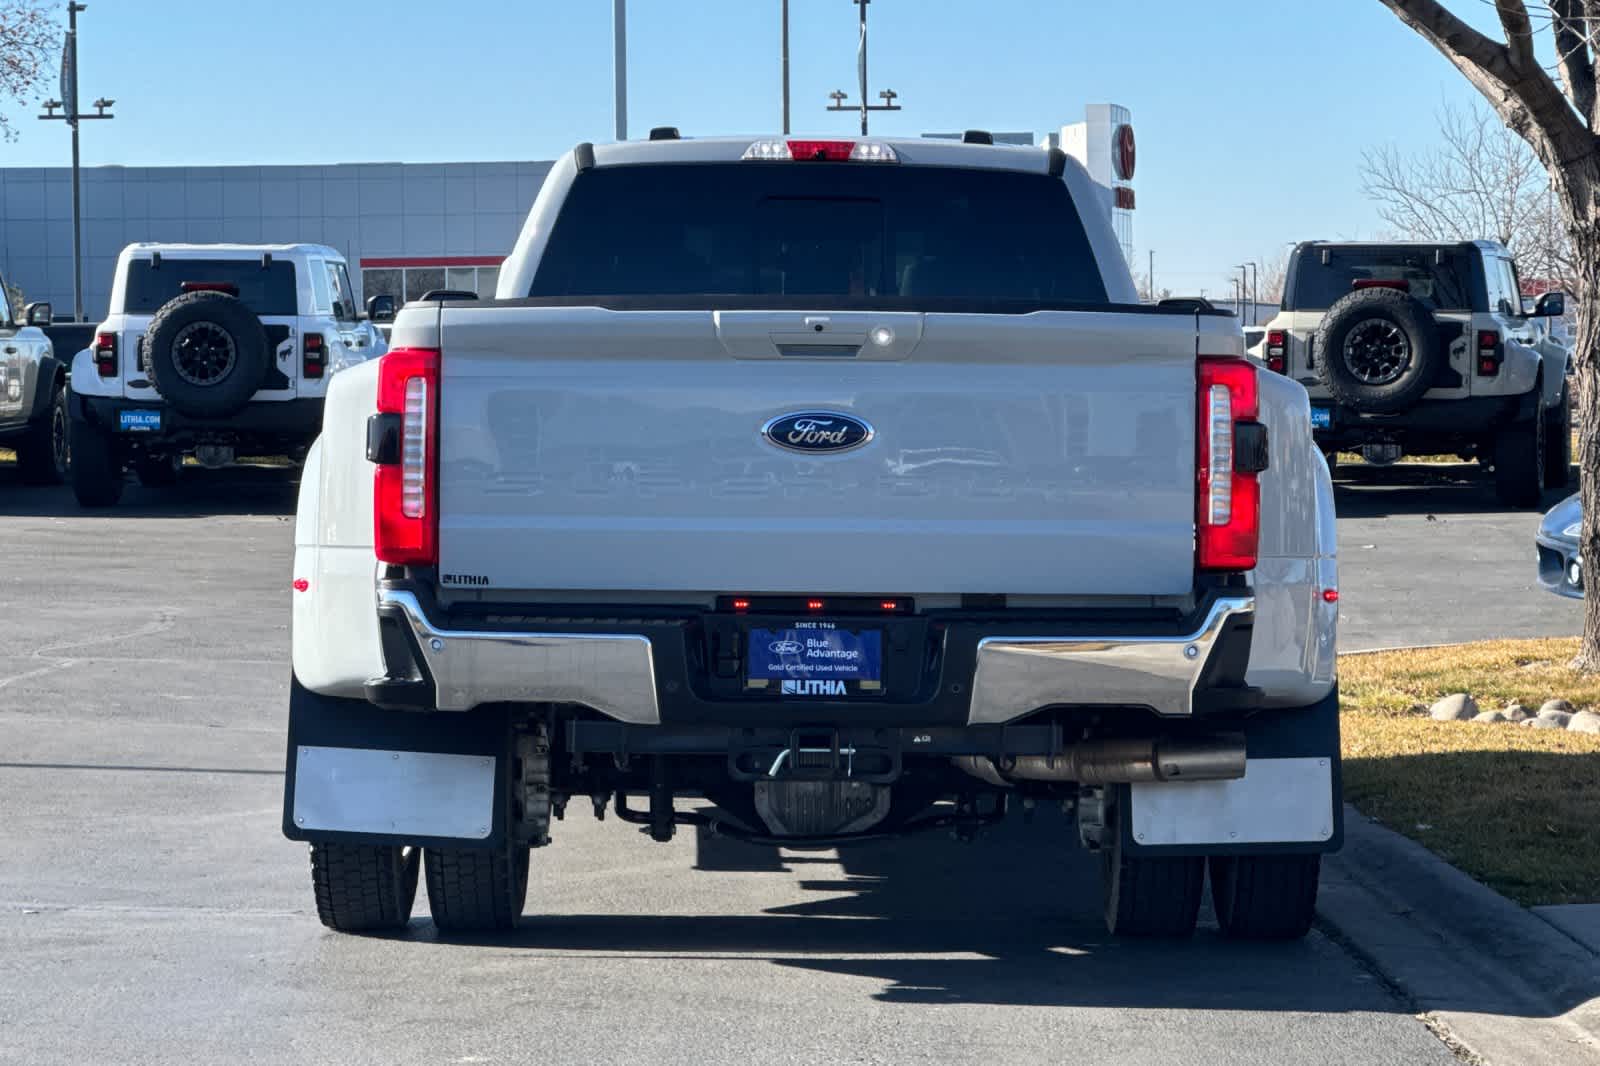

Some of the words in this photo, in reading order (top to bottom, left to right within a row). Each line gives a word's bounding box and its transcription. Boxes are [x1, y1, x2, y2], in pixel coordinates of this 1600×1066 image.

[788, 419, 848, 443] Ford
[453, 575, 489, 585] LITHIA
[807, 639, 829, 648] Blue
[807, 649, 859, 660] Advantage
[785, 664, 814, 672] Certified
[797, 680, 847, 695] LITHIA
